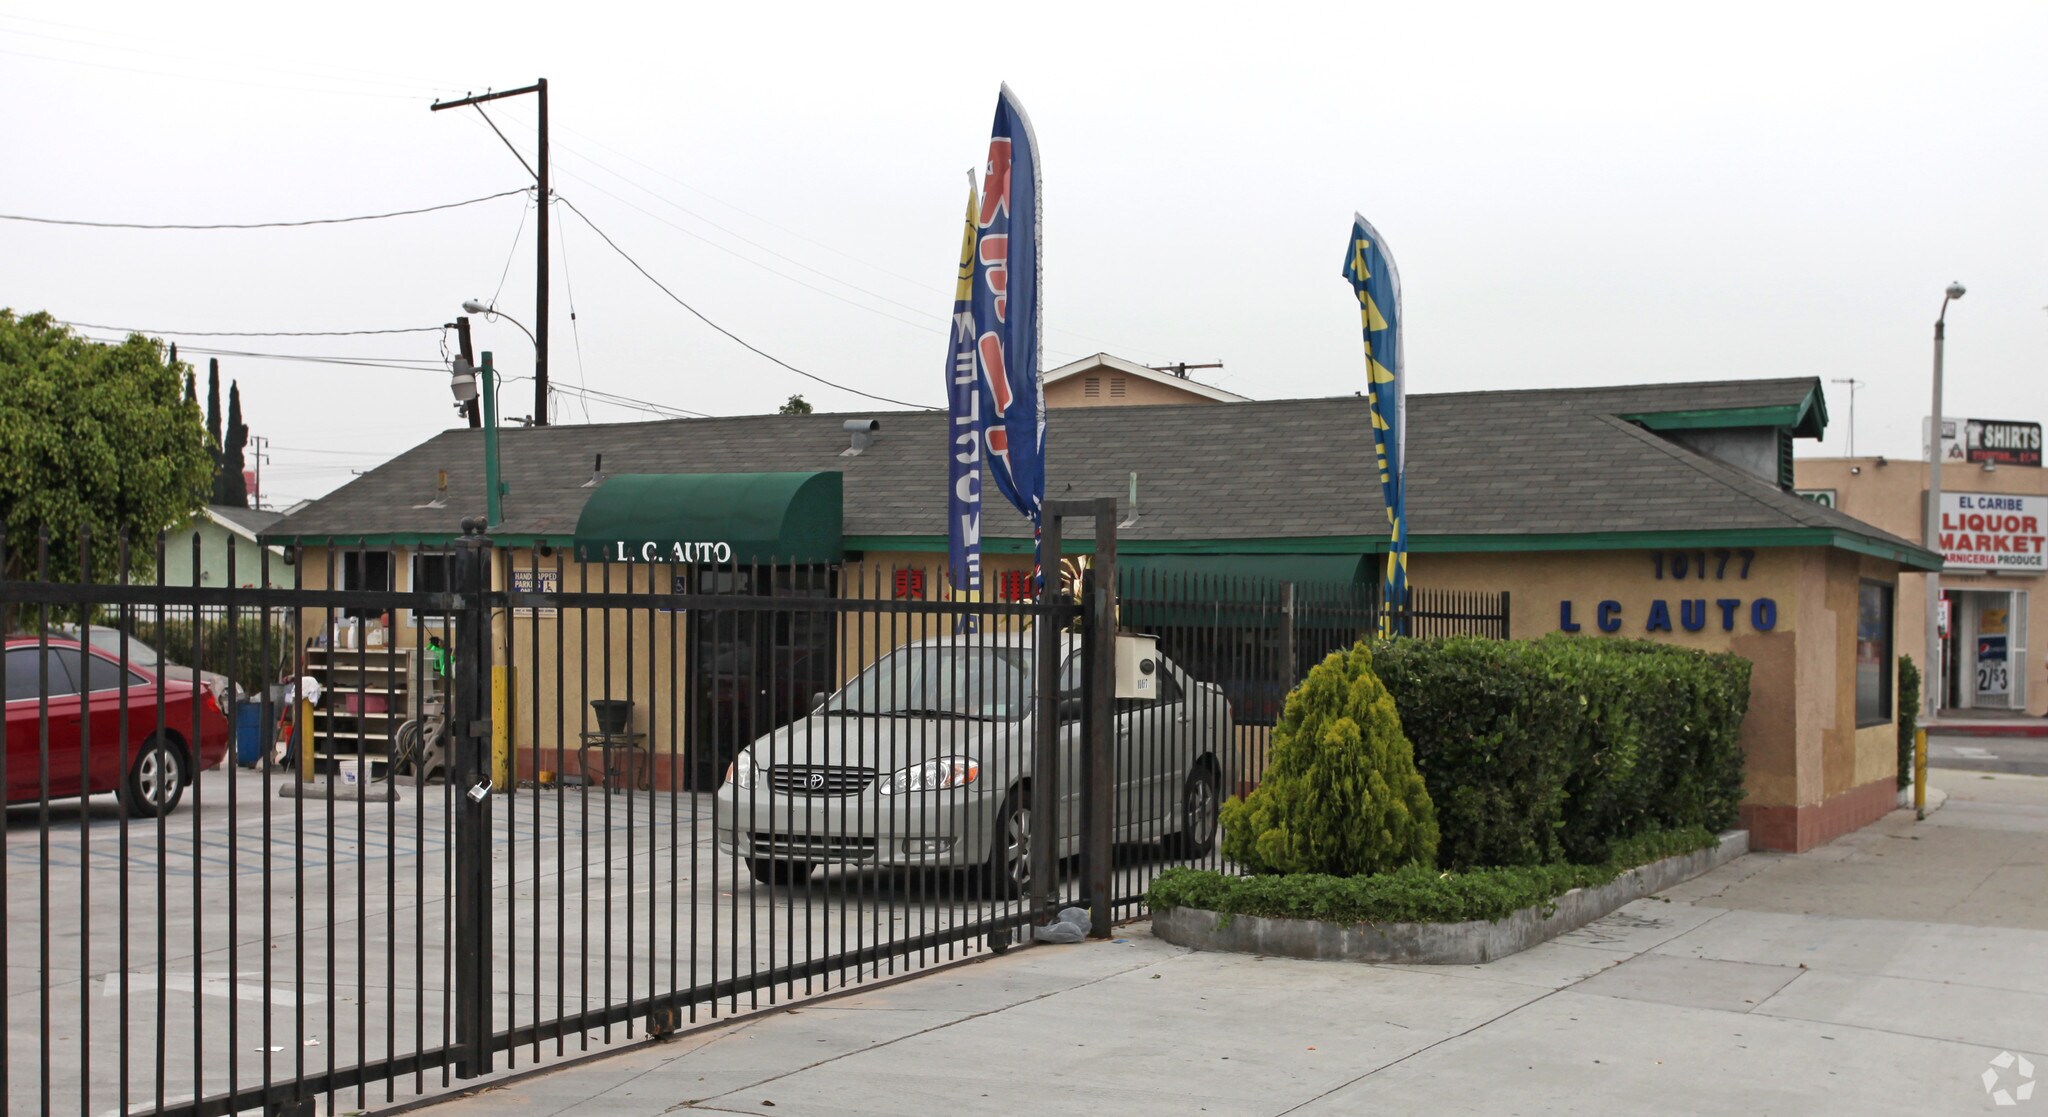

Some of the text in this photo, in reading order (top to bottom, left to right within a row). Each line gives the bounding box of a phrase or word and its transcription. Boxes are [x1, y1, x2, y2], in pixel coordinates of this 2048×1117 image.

[1984, 424, 2040, 450] SHIRTS
[1959, 496, 2023, 511] EL CARIBE
[1942, 513, 2037, 533] LIQUOR
[641, 541, 663, 562] C.
[669, 541, 731, 563] AUTO
[1938, 533, 2045, 553] MARKET
[1652, 552, 1754, 580] 10177
[1941, 552, 2042, 566] ARNICERIA PRODUCE
[1646, 597, 1777, 632] AUTO
[1978, 668, 2008, 691] 2/$3
